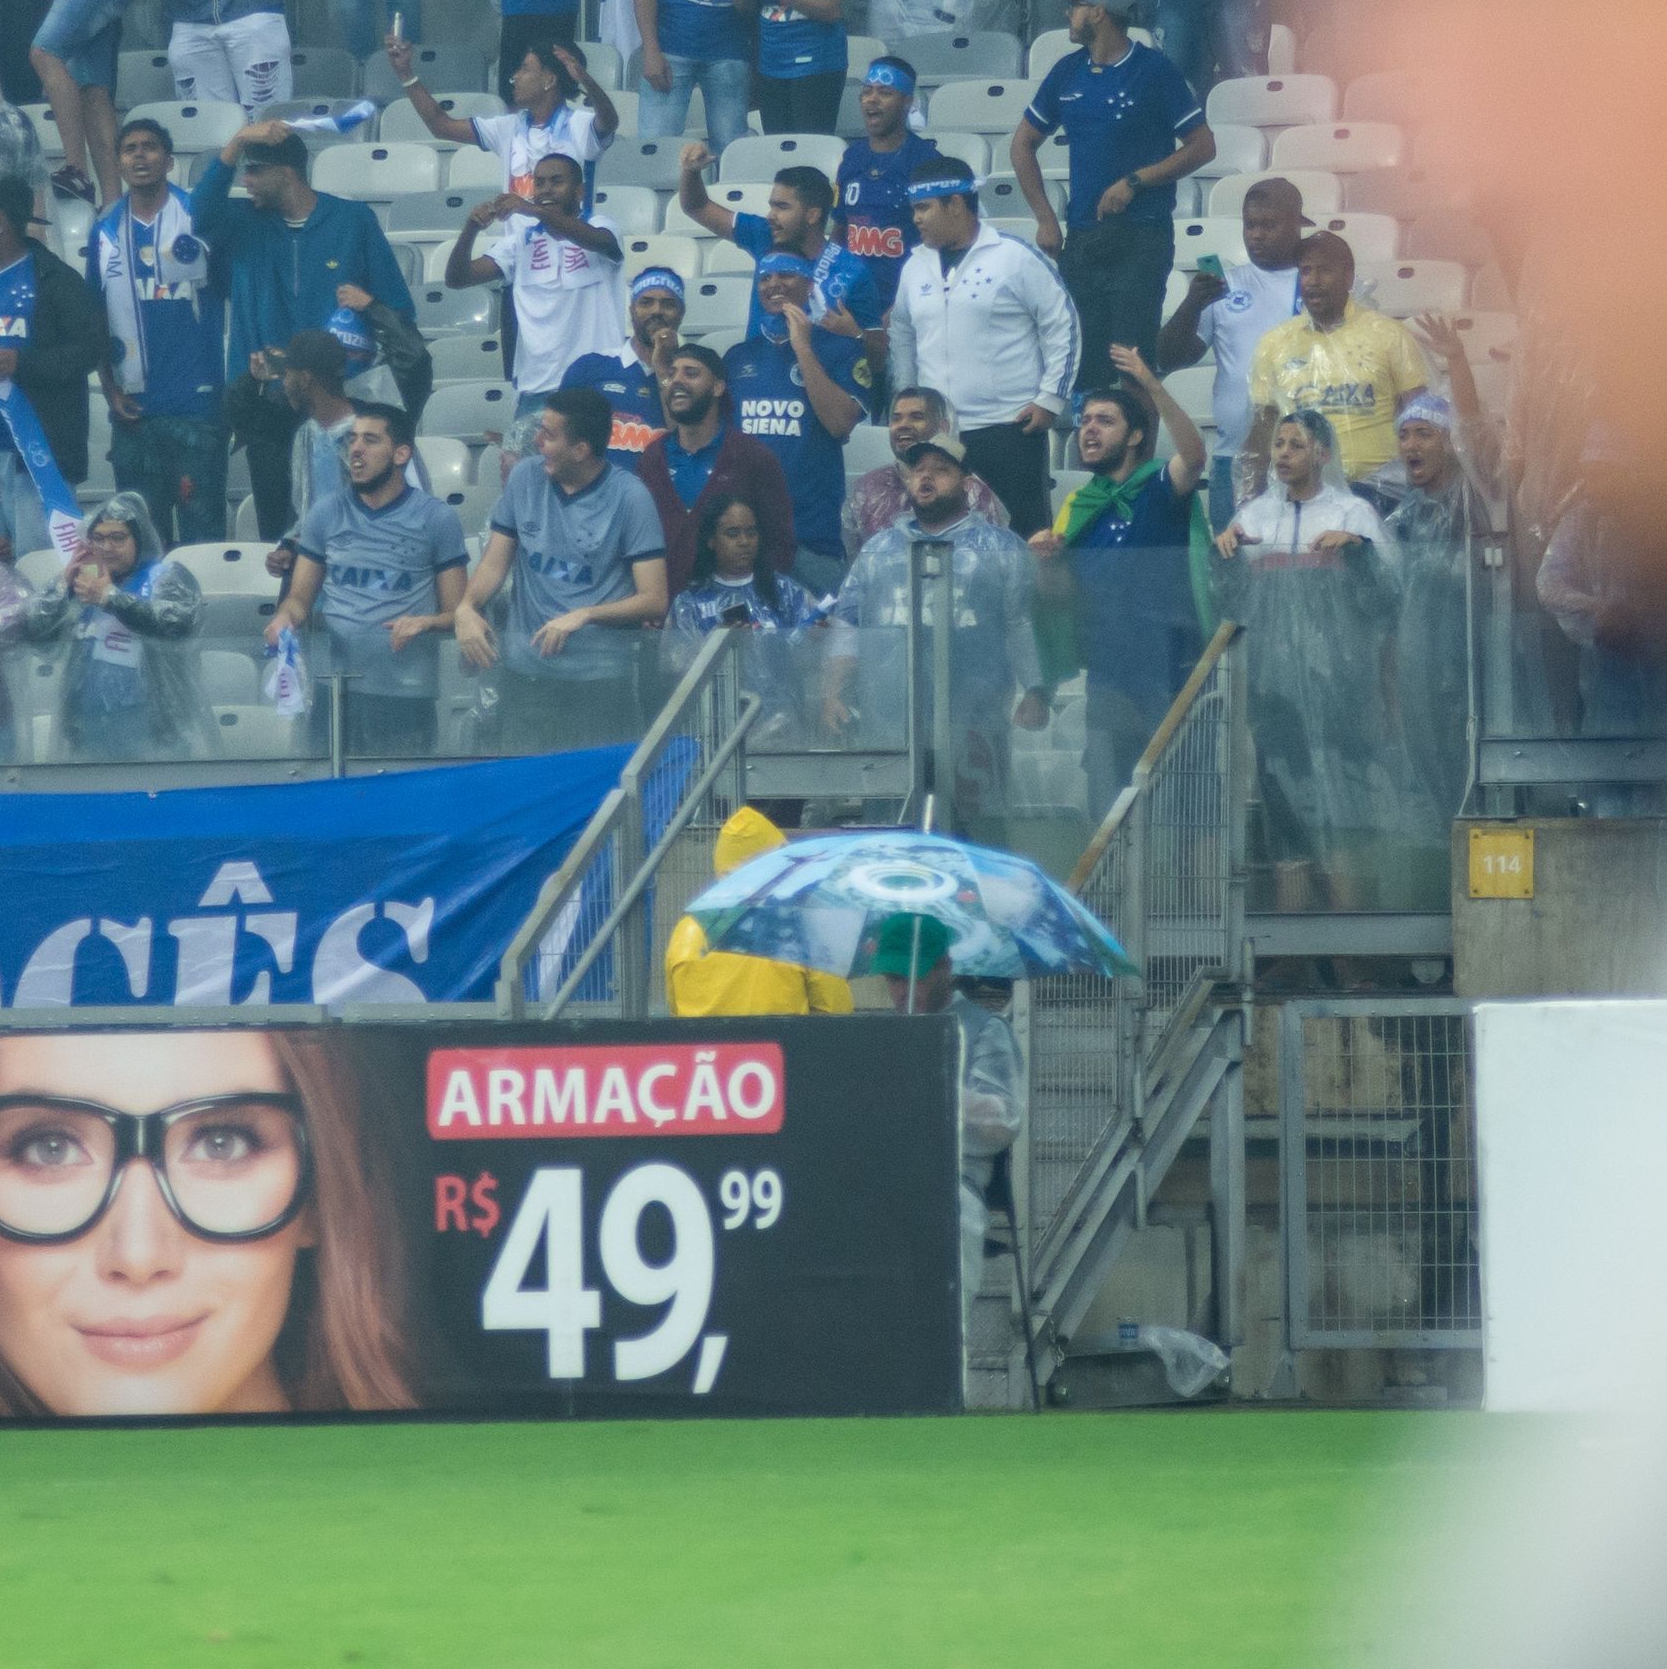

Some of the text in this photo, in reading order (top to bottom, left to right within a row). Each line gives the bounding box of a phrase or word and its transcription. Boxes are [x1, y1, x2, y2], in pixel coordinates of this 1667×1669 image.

[741, 399, 805, 418] NOVO
[741, 416, 802, 437] SIENA
[53, 518, 76, 555] FIA
[1482, 853, 1523, 875] 114
[438, 1048, 779, 1138] ARMAÇÃO
[435, 1161, 782, 1396] R$ 49, 99
